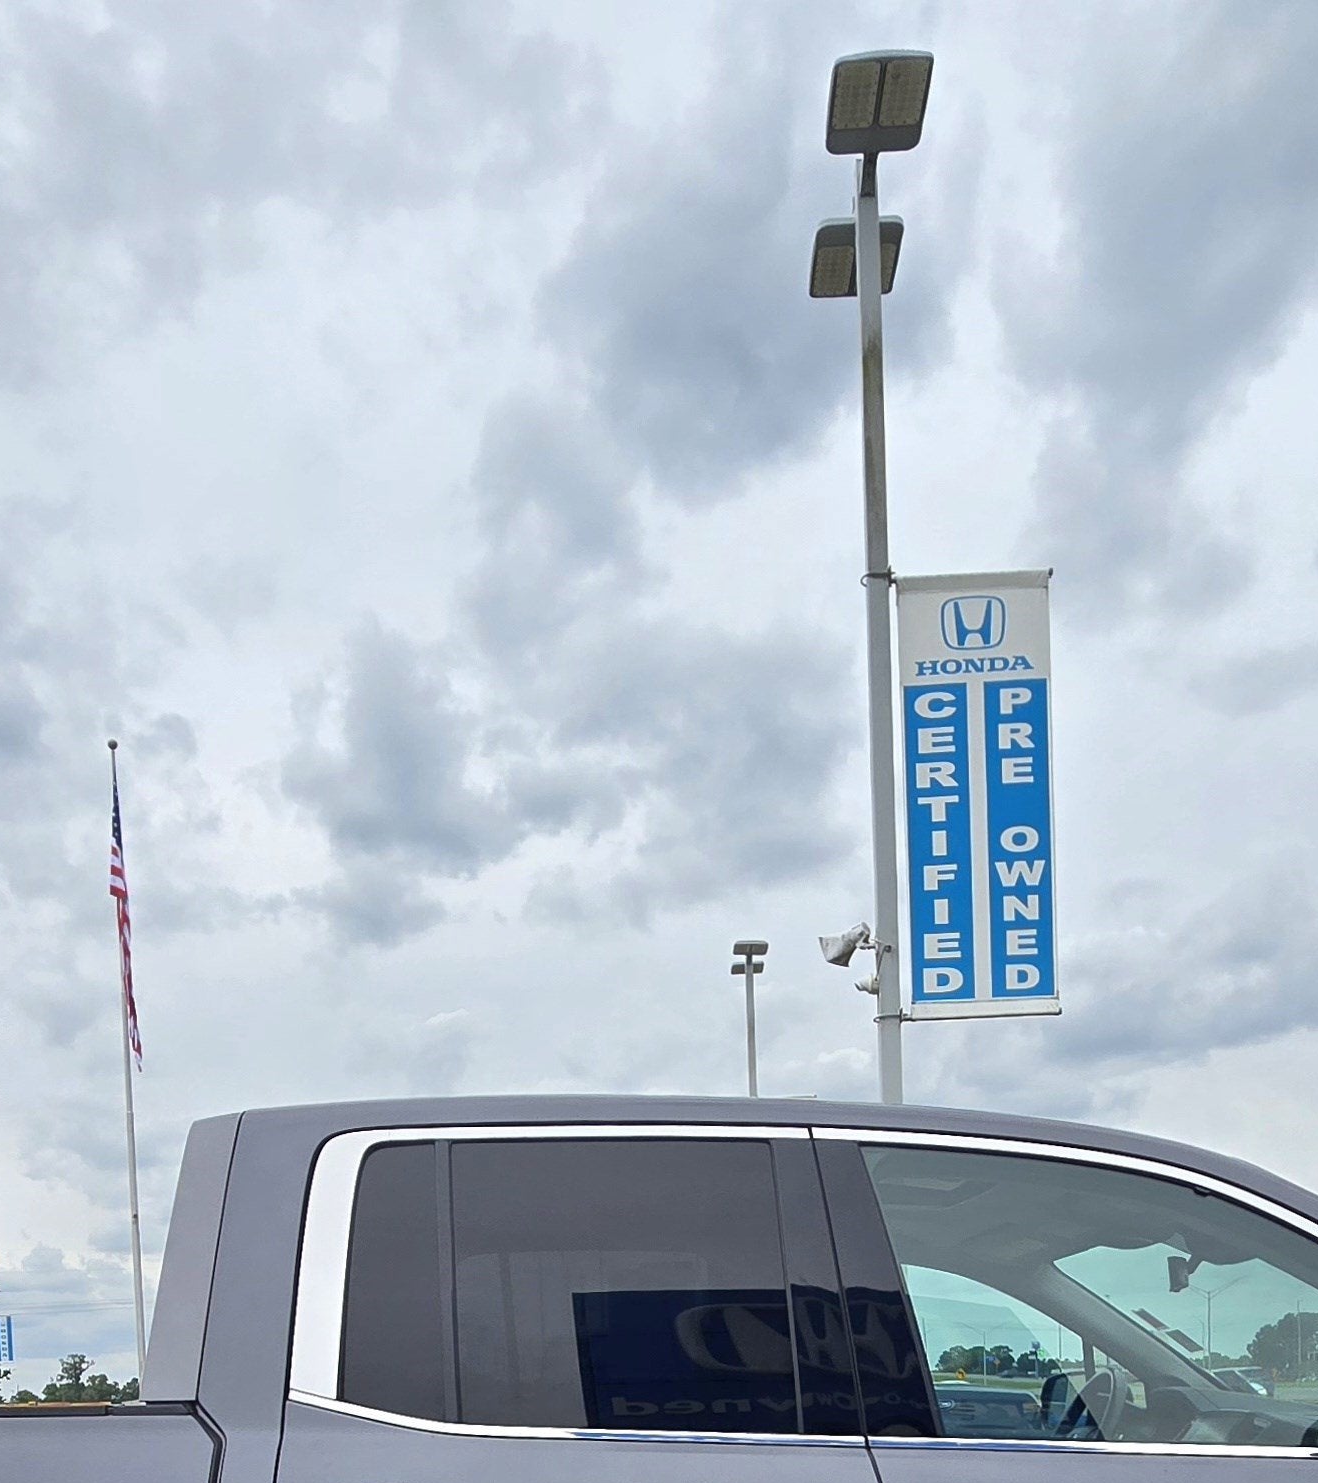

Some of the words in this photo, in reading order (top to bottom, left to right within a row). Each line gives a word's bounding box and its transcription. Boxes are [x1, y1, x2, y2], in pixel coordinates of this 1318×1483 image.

[914, 655, 1034, 677] HONDA
[997, 687, 1036, 785] PRE
[913, 691, 965, 994] CERTIFIED
[993, 825, 1046, 991] OWNED
